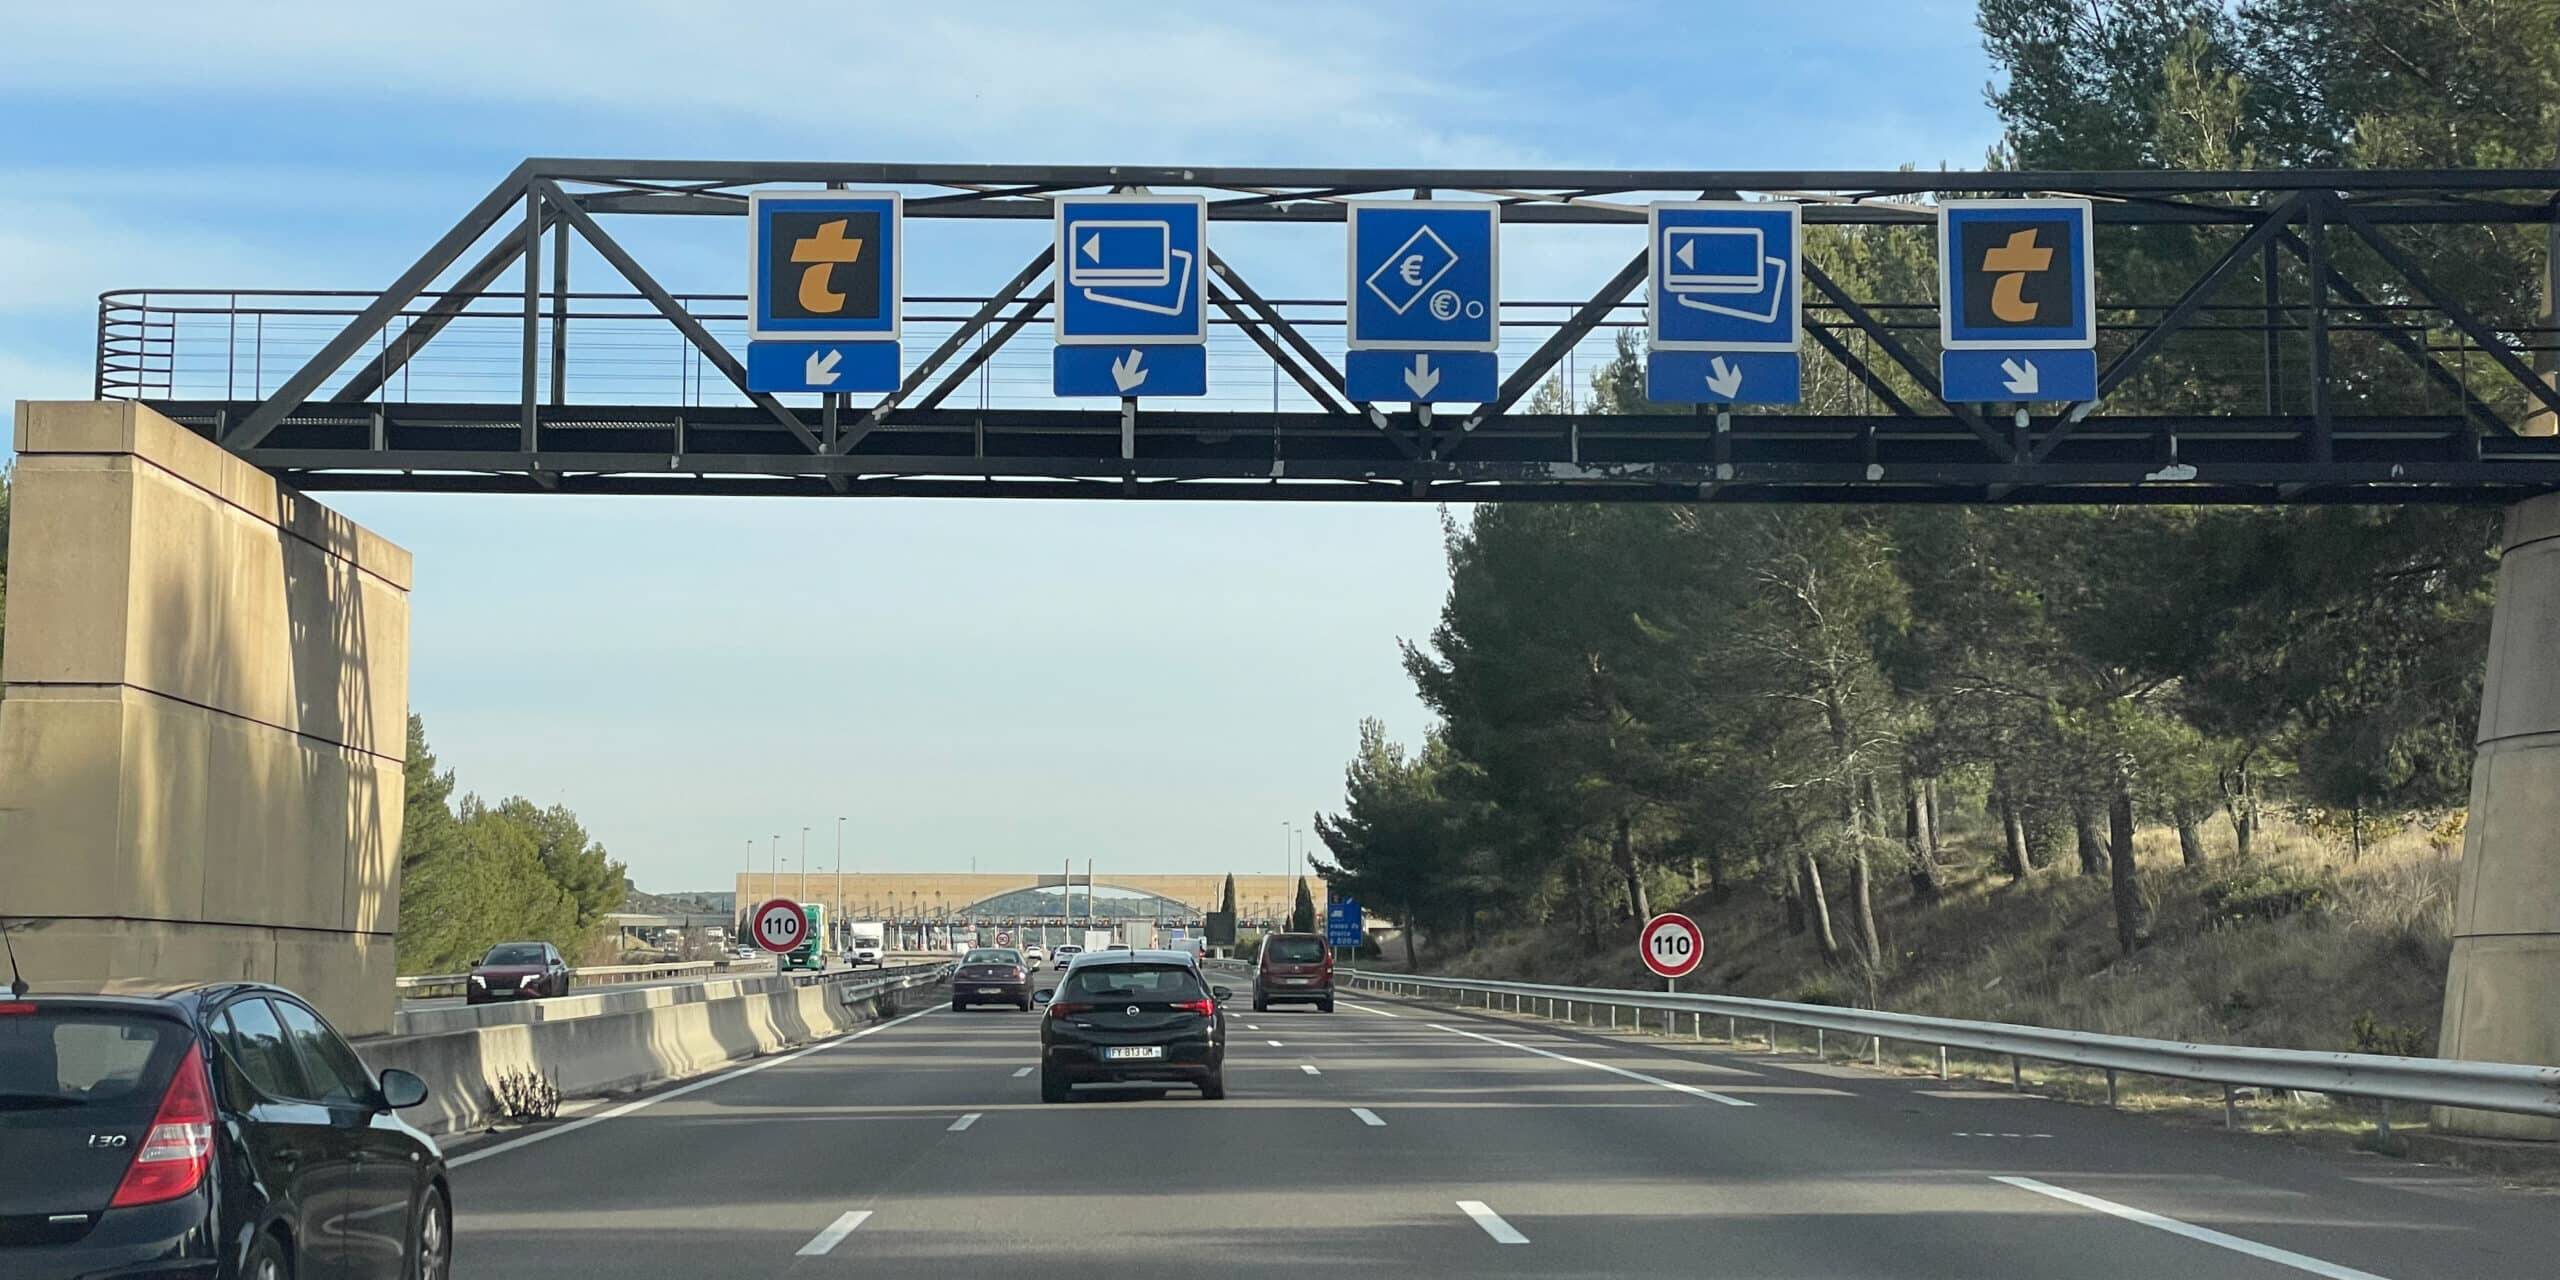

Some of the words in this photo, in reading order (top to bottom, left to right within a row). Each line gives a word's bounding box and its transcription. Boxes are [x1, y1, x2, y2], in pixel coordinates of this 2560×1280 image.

[790, 218, 863, 313] t
[1982, 227, 2053, 322] t
[765, 917, 796, 935] 110
[1654, 935, 1690, 955] 110
